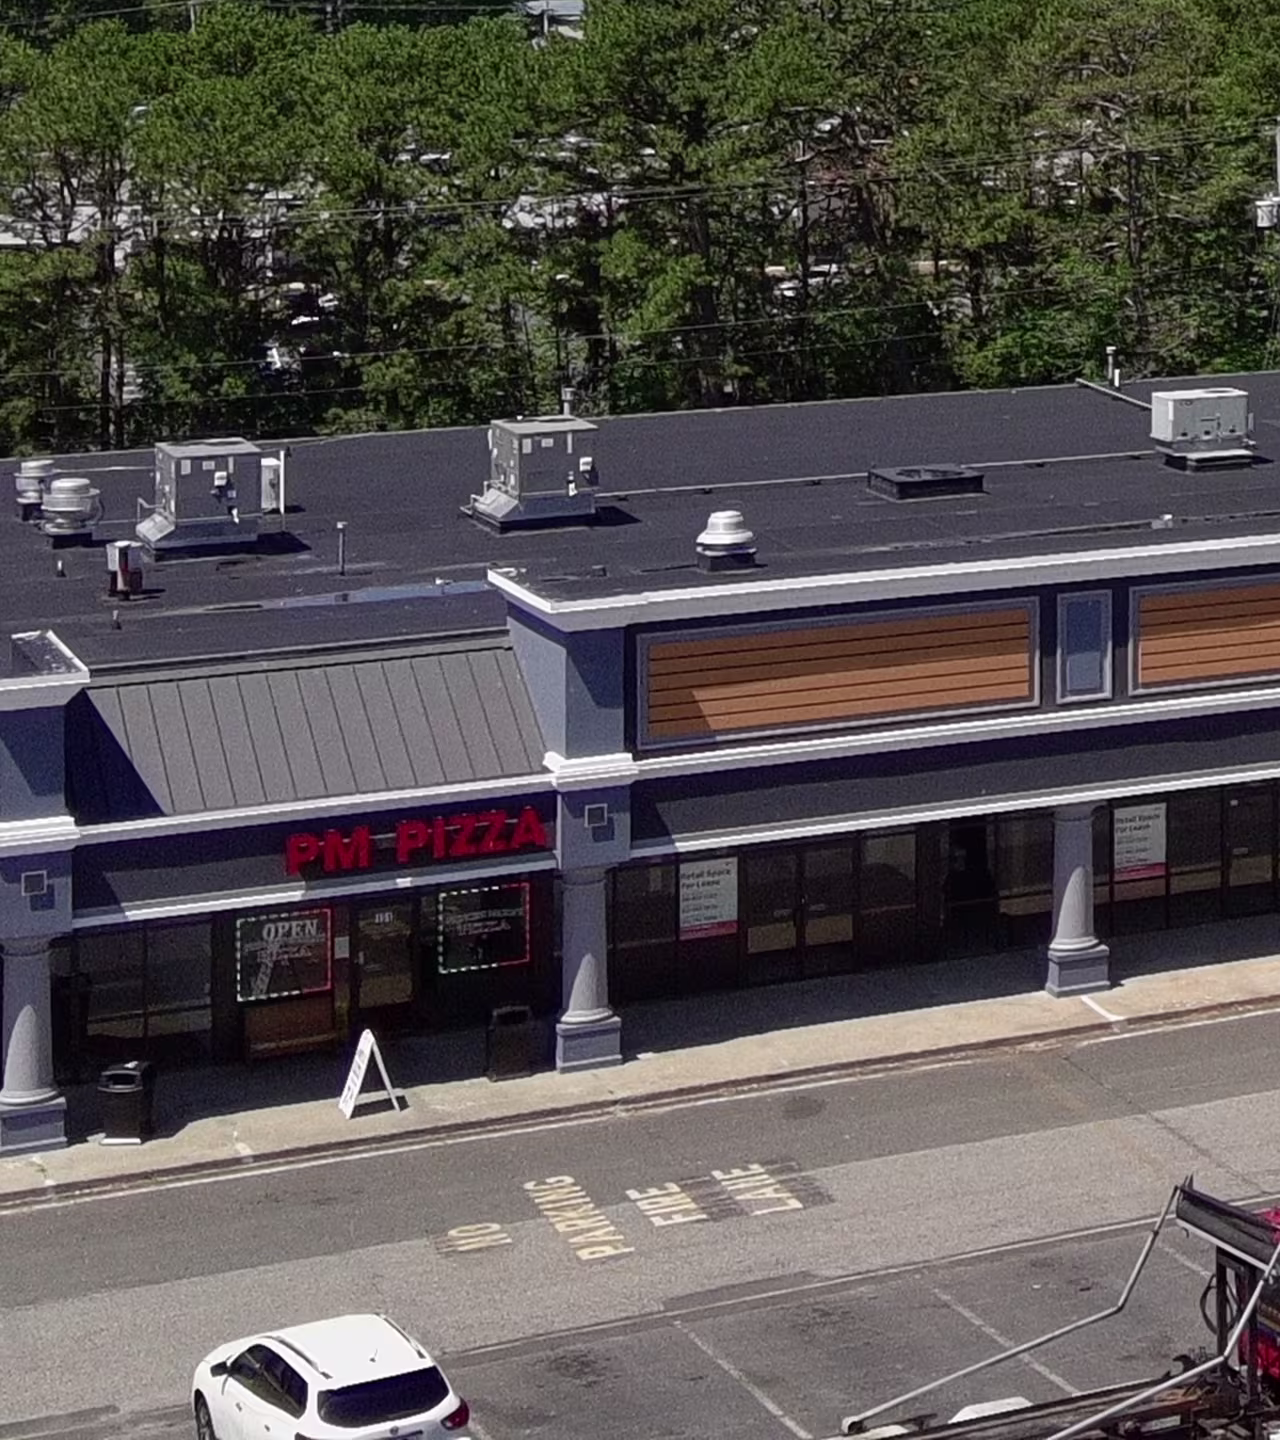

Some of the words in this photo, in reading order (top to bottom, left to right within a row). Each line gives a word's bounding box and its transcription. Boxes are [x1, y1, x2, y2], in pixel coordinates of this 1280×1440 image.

[285, 825, 373, 876] PM
[396, 806, 547, 863] PIZZA
[262, 919, 319, 940] OPEN
[523, 1174, 636, 1261] PARKING
[625, 1181, 708, 1227] FIRE
